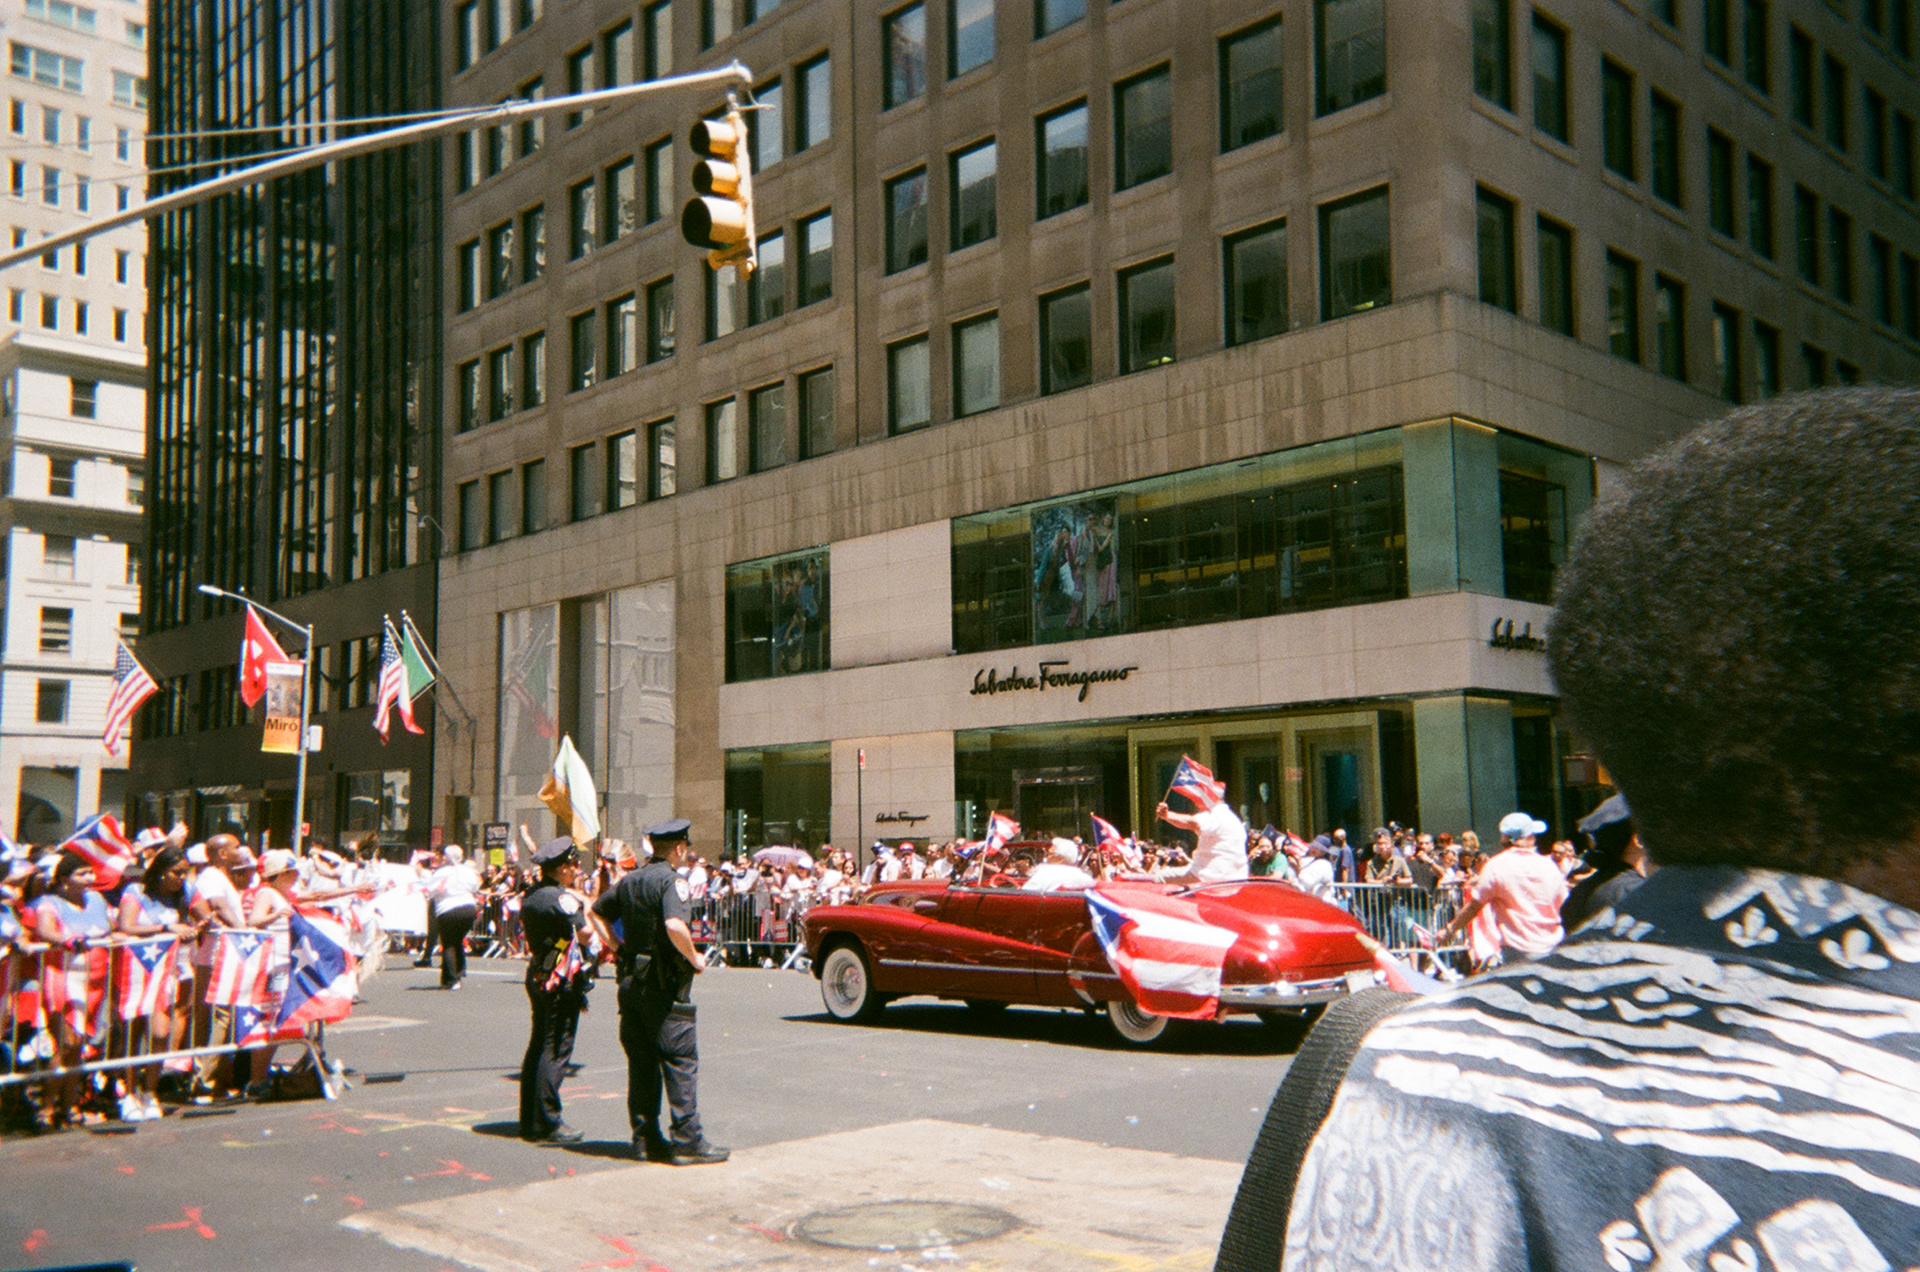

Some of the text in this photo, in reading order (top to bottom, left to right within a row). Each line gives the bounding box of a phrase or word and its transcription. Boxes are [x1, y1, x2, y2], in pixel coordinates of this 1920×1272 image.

[970, 660, 1138, 702] Salvatore Ferragamo
[265, 717, 299, 731] Miró
